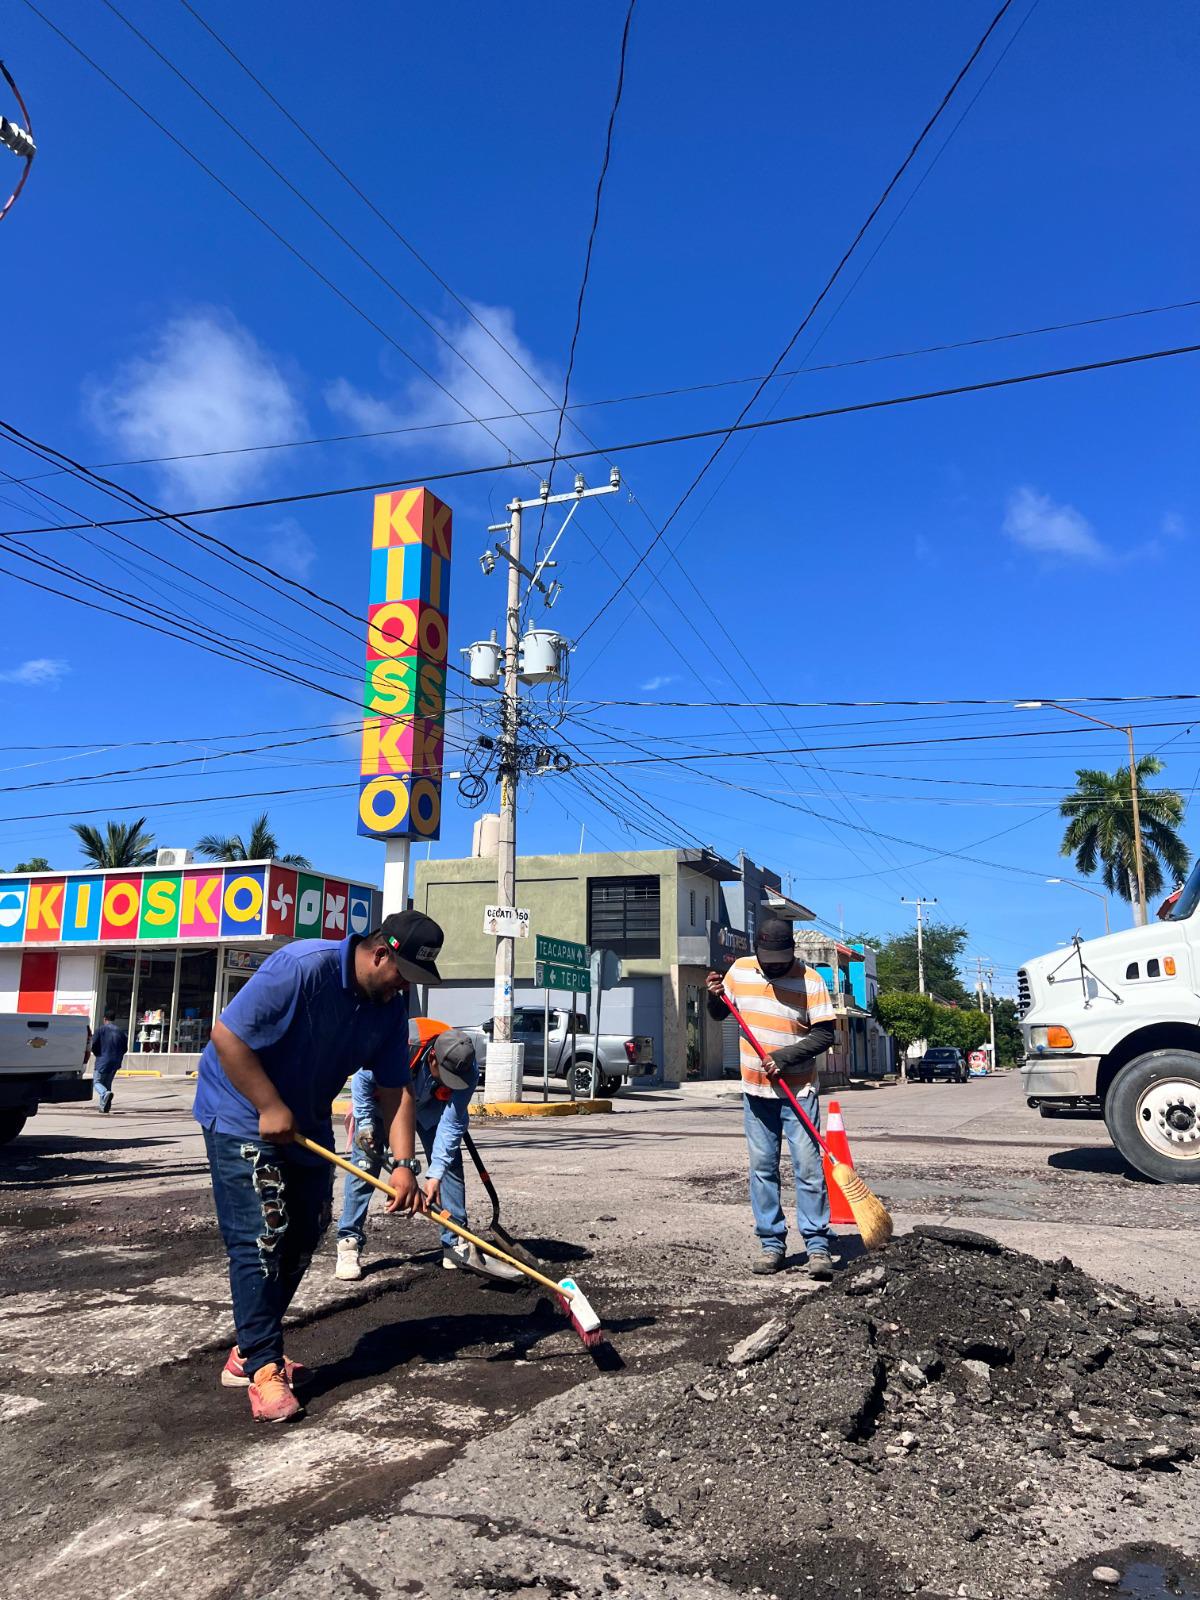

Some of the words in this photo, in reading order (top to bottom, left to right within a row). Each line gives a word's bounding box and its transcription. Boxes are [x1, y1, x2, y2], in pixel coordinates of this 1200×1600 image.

[359, 486, 425, 832] KIOSKO
[410, 489, 451, 836] KIOSKO
[26, 876, 263, 930] KIOSKO
[487, 909, 512, 919] CECATI
[539, 940, 577, 961] TEACAPAN
[561, 971, 586, 988] TEPIC
